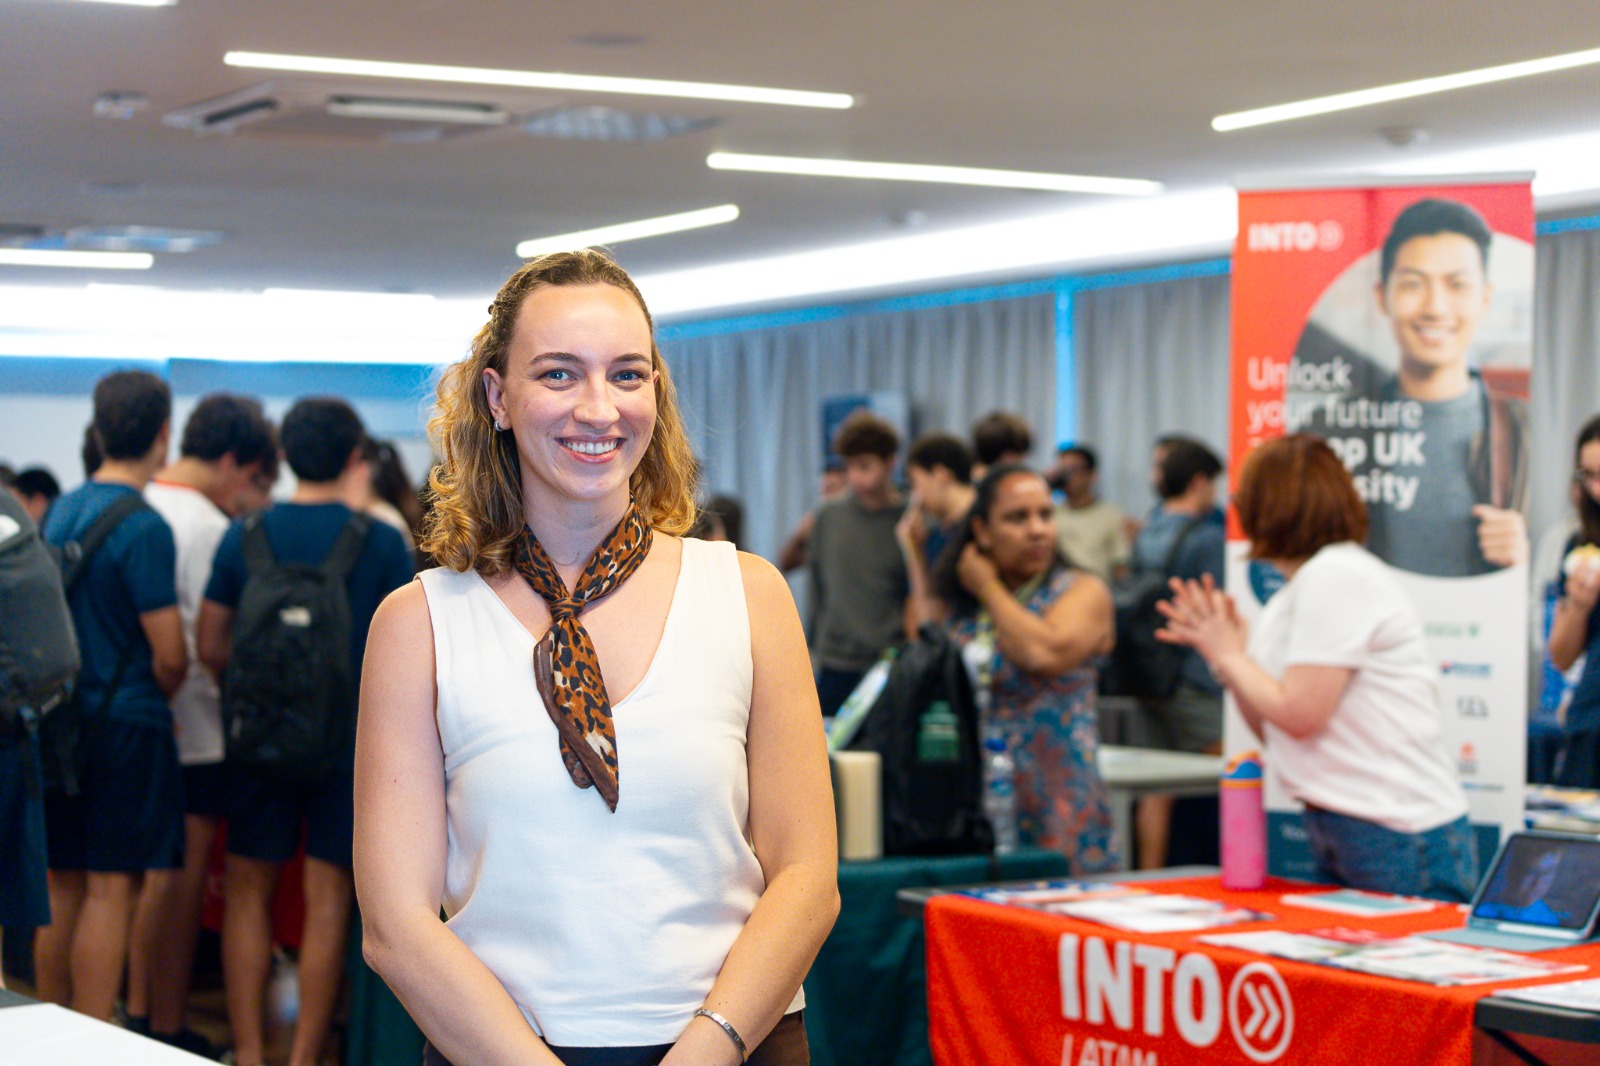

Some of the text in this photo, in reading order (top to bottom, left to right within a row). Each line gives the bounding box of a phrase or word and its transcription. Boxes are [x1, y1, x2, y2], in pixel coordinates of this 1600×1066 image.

[1248, 222, 1317, 251] INTO
[1248, 357, 1351, 390] Unlock
[1246, 395, 1423, 435] your future
[1373, 432, 1426, 465] UK
[1058, 933, 1223, 1047] INTO
